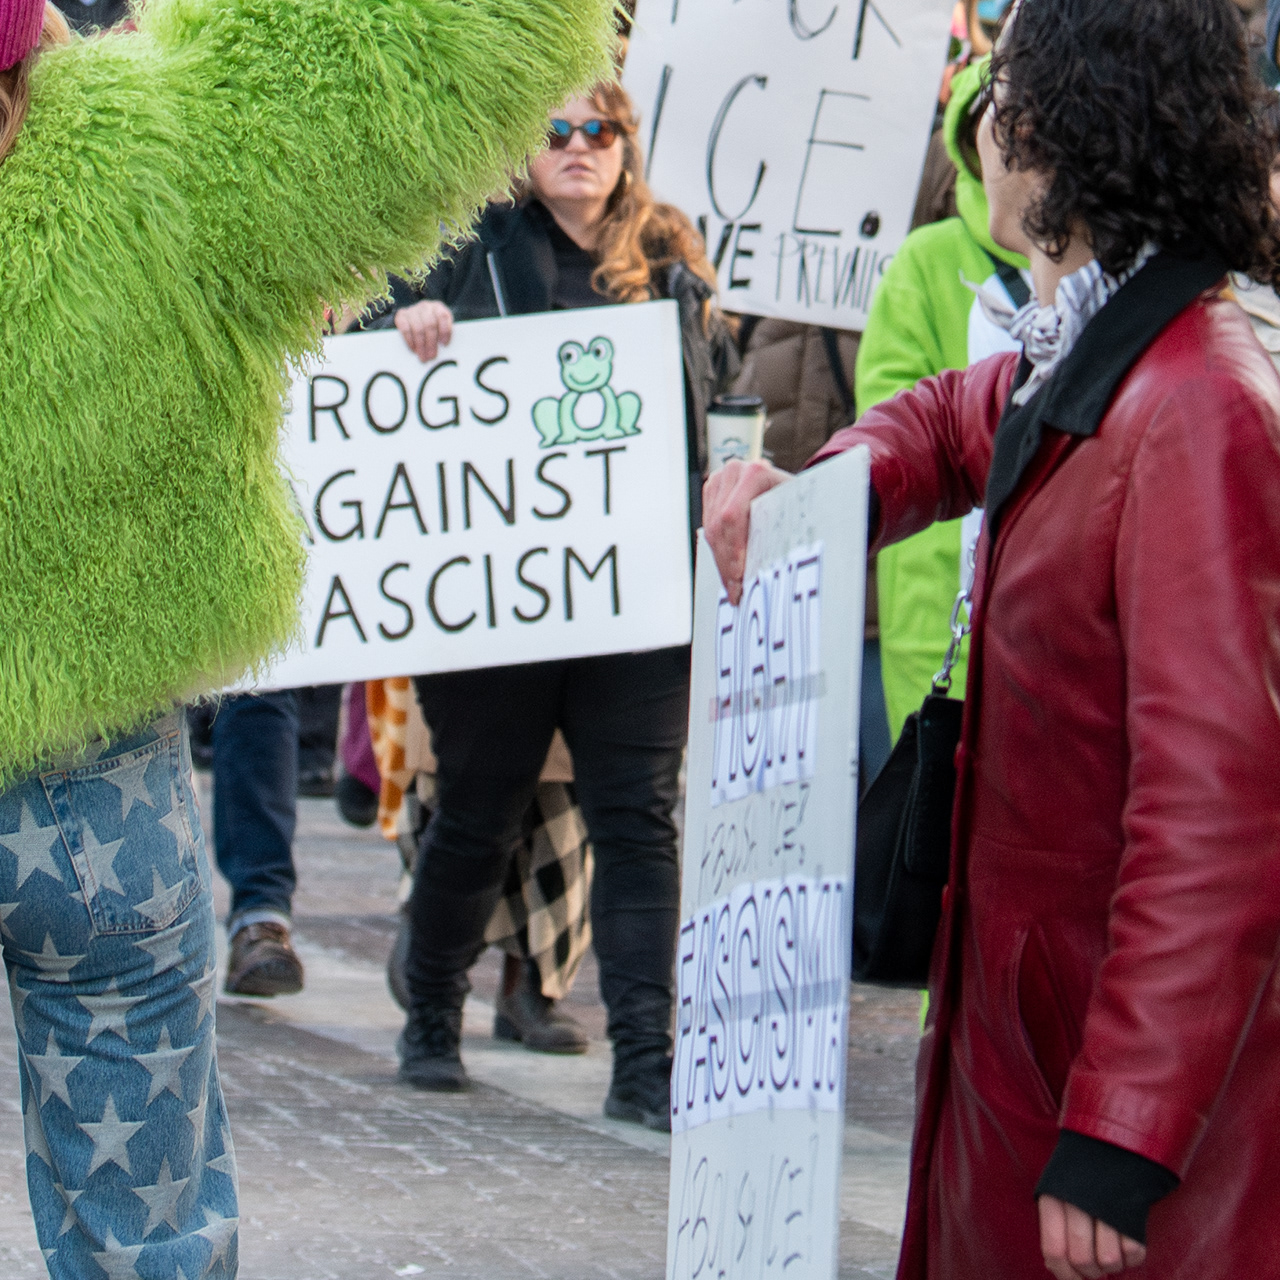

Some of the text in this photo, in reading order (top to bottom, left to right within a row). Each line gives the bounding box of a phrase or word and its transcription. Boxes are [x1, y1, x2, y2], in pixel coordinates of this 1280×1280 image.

[645, 64, 880, 238] ICE.
[306, 355, 511, 443] ROGS
[293, 445, 628, 546] GAINST
[314, 544, 622, 649] ASCISM
[711, 554, 823, 790] FIGHT
